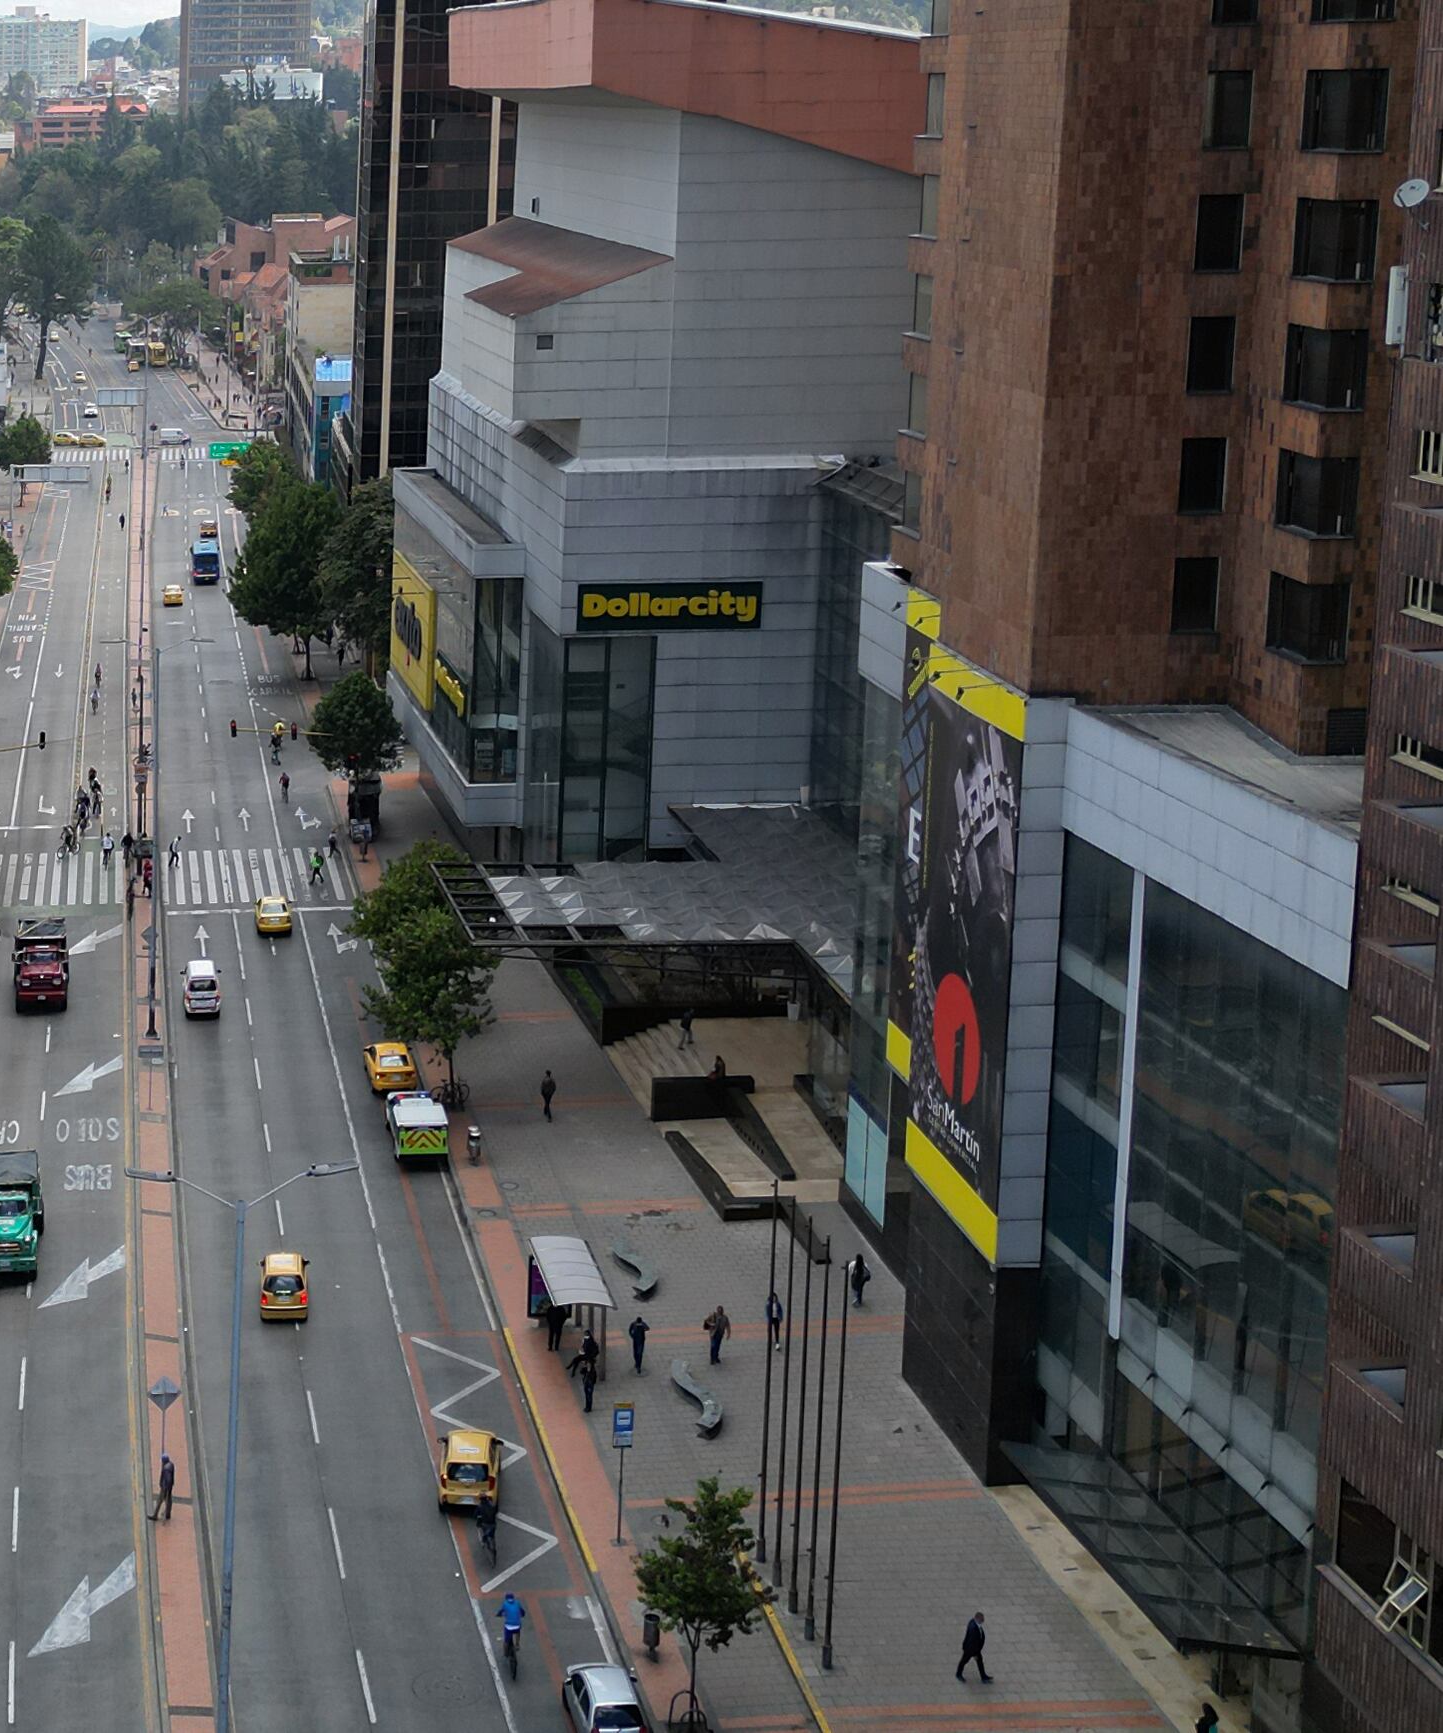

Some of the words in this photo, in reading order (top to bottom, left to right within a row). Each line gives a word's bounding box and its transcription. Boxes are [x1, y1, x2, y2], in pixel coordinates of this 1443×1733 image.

[582, 589, 757, 622] Dollarcity
[12, 635, 33, 643] BUS
[64, 1163, 112, 1191] BUS
